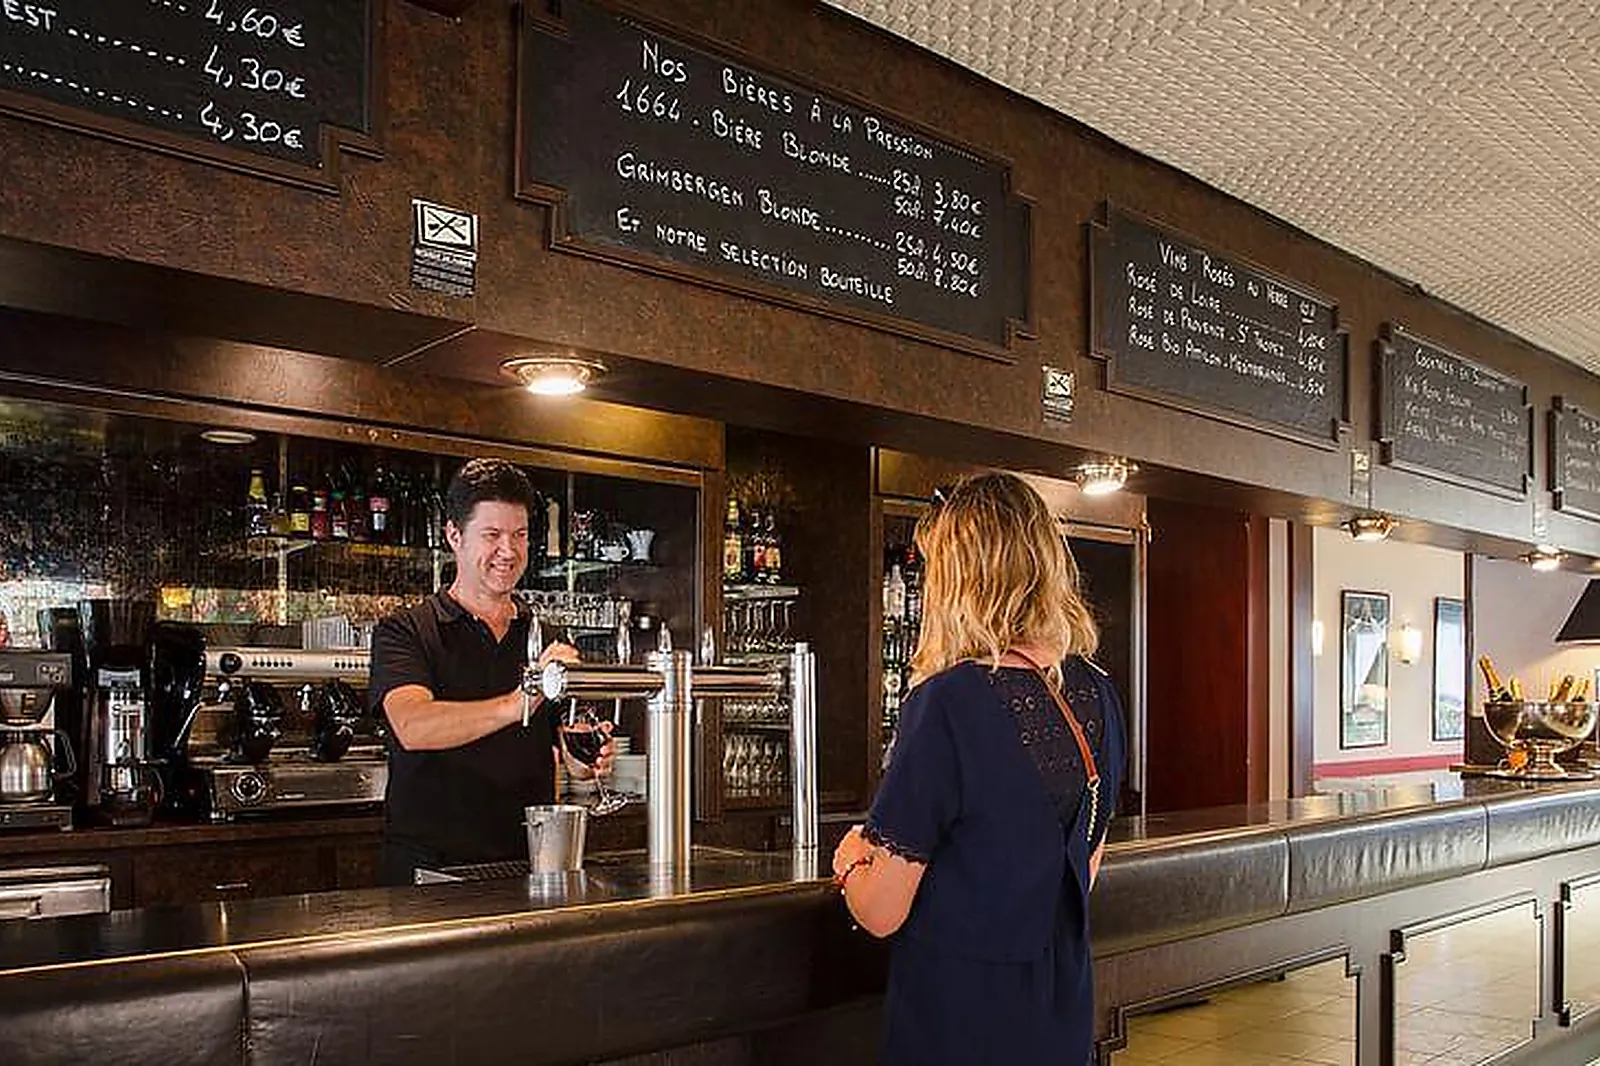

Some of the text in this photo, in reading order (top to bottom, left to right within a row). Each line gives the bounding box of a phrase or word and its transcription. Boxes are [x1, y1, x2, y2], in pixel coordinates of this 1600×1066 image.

[204, 0, 305, 47] 4,60€
[203, 45, 305, 98] 4,30€
[200, 101, 304, 149] 4,30€
[616, 79, 680, 121] 1664
[782, 131, 851, 173] BLONDE
[863, 117, 933, 159] PRESSION
[617, 153, 743, 206] GRIMBERGEN
[758, 189, 821, 231] BLONDE
[656, 224, 707, 252] NOTRE
